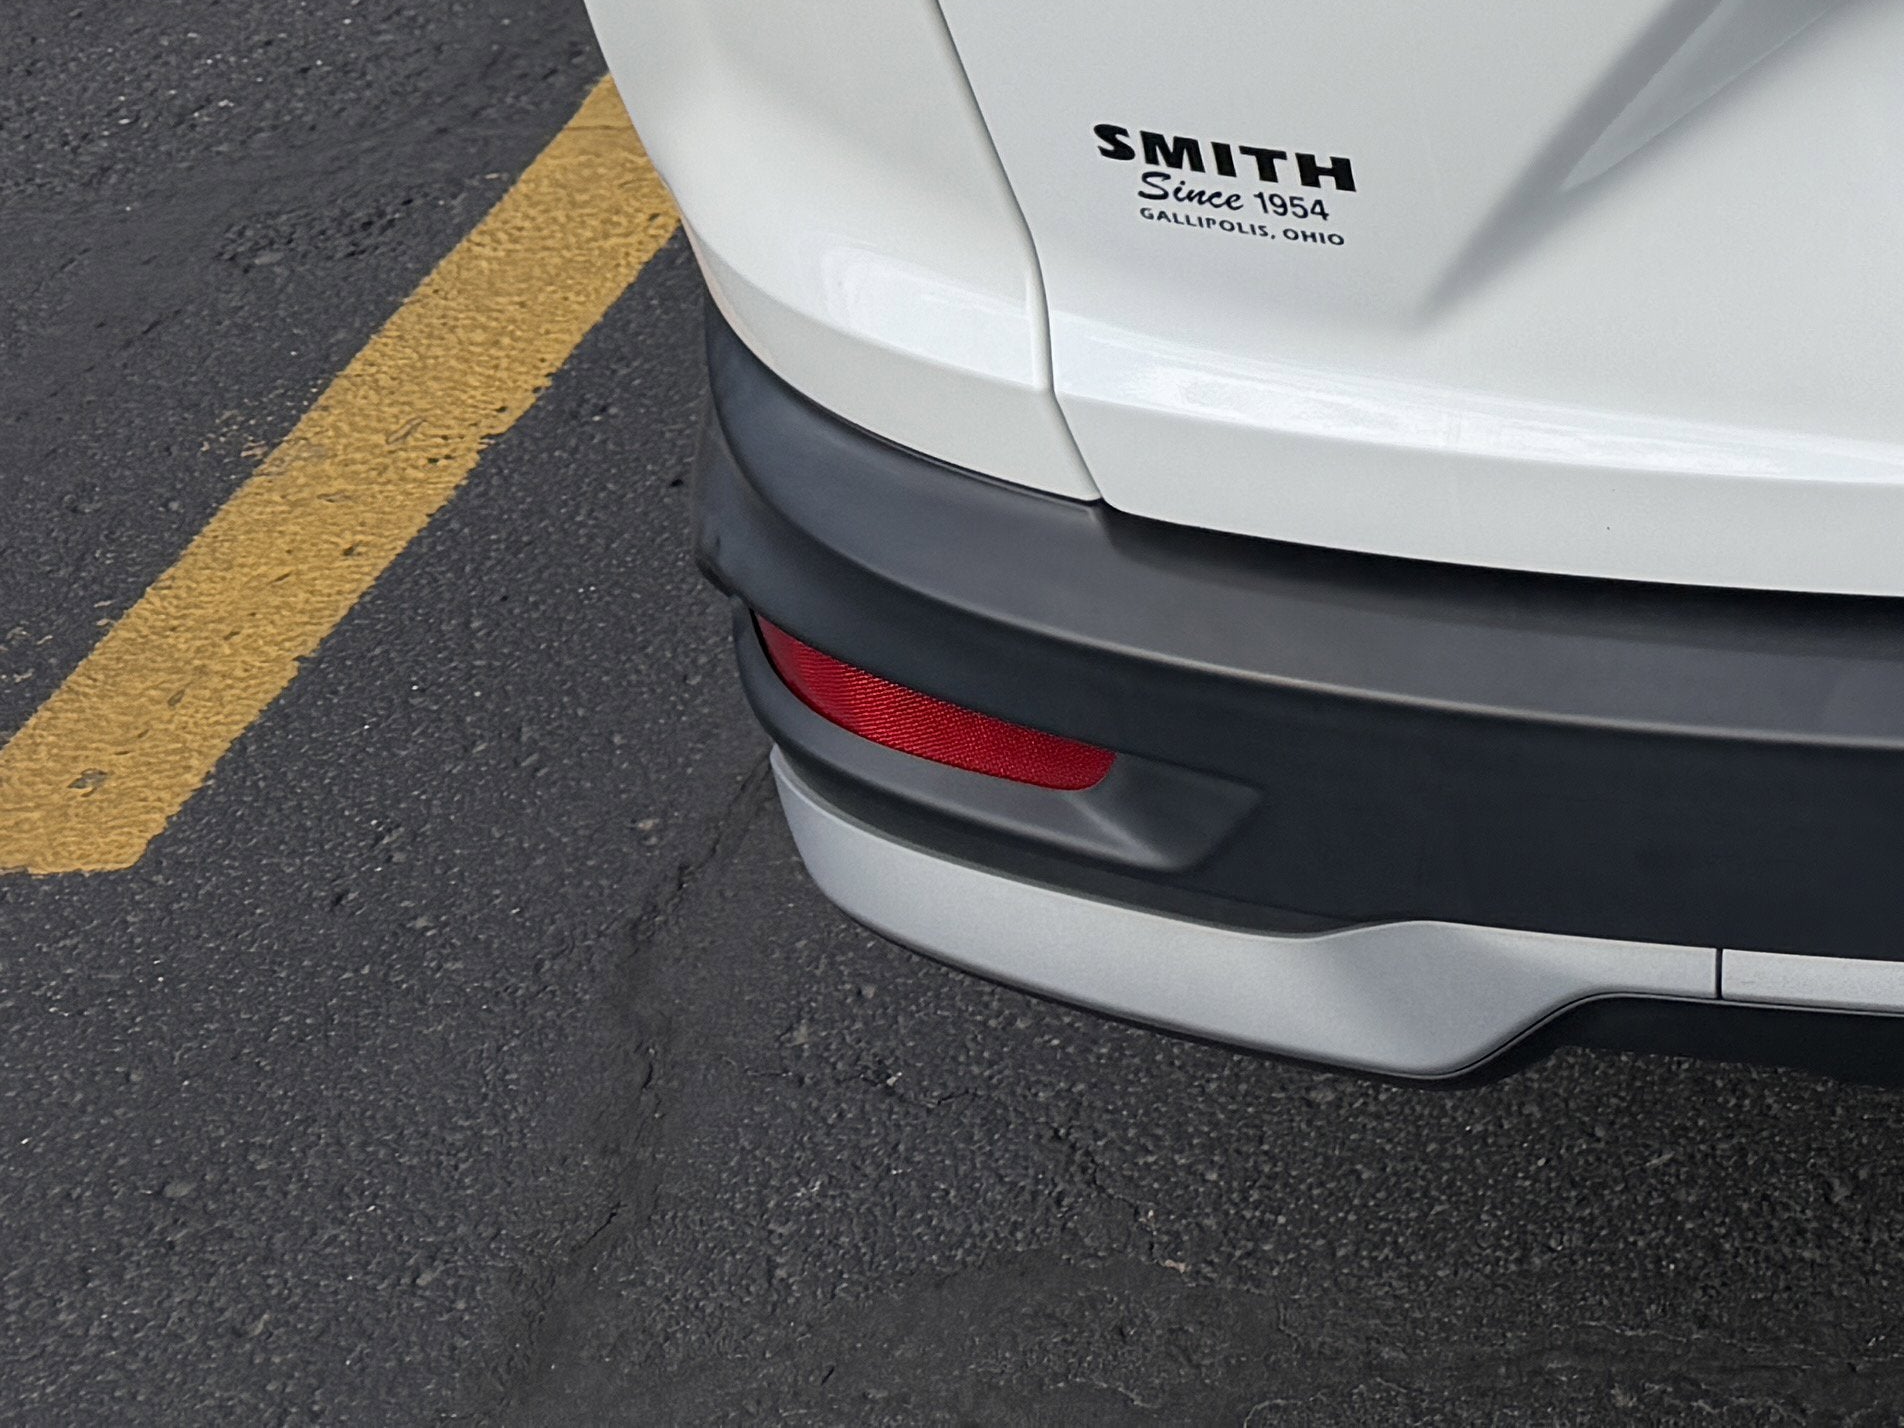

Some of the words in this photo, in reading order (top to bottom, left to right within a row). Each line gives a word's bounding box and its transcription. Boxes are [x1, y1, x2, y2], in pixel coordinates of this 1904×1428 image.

[1093, 124, 1357, 192] SMITH
[1137, 171, 1244, 211] Since
[1254, 191, 1330, 231] 1954
[1139, 207, 1276, 240] GALLIPOLIS,
[1282, 227, 1345, 246] OHIO
